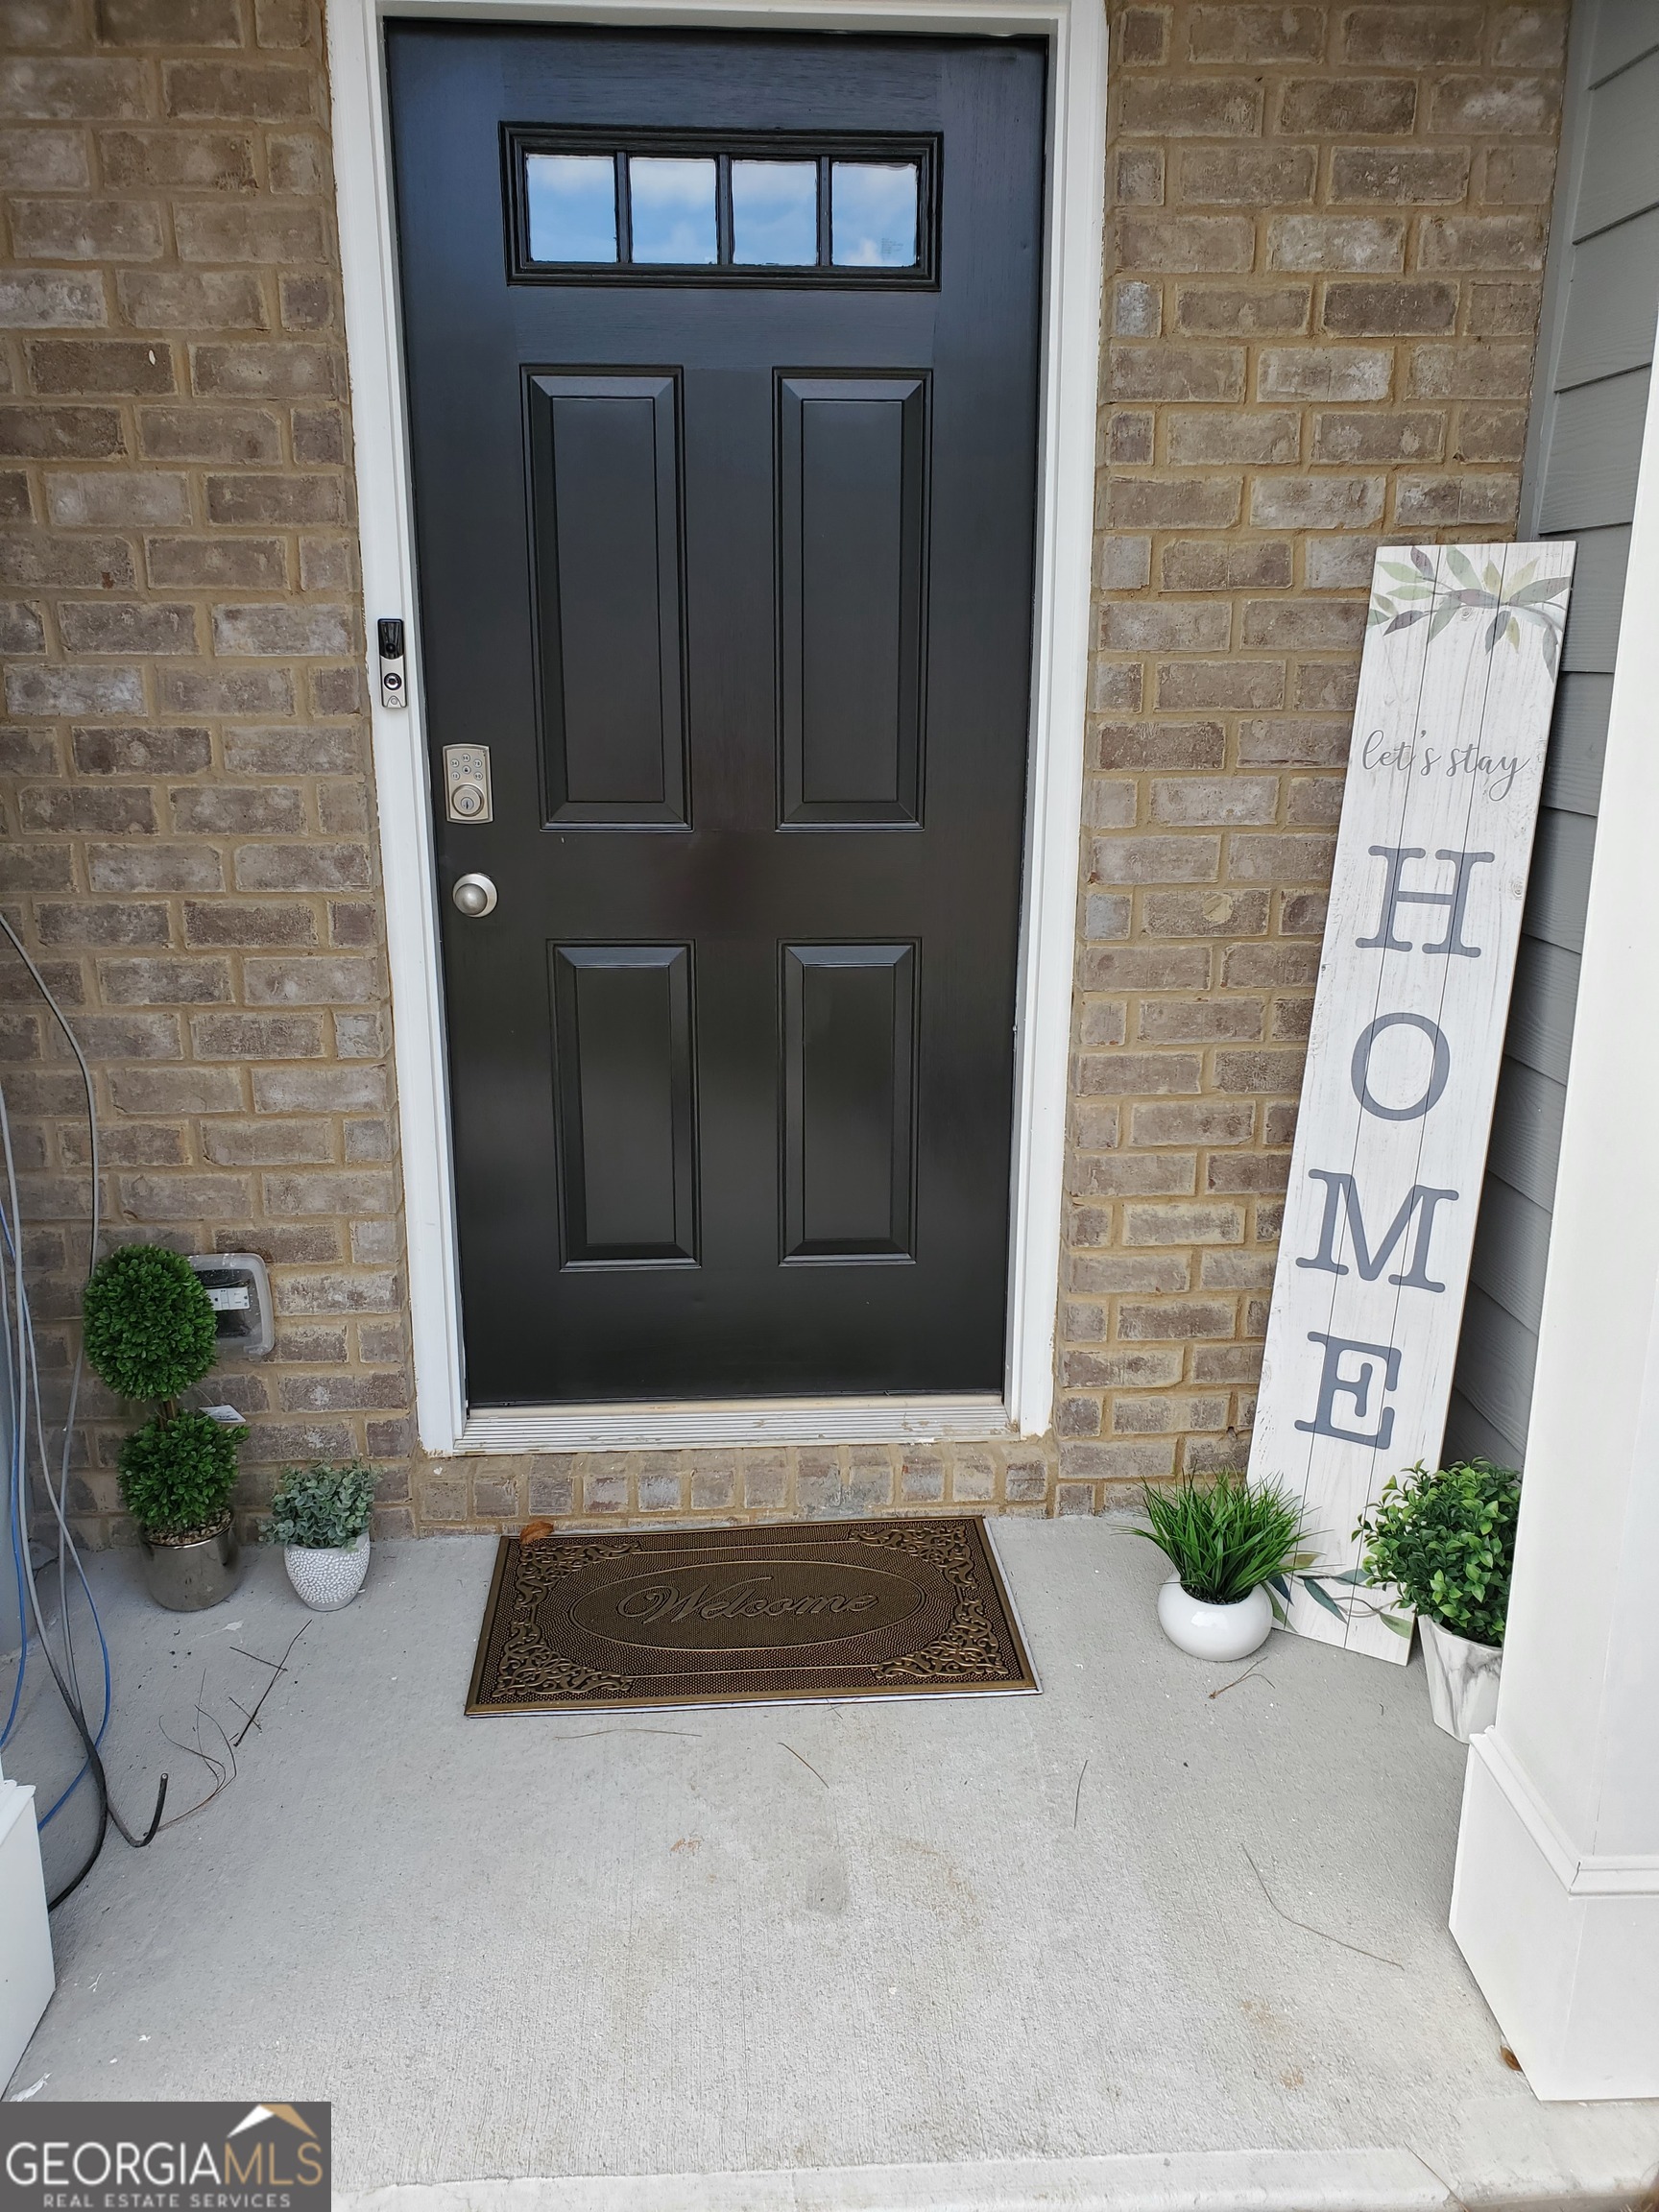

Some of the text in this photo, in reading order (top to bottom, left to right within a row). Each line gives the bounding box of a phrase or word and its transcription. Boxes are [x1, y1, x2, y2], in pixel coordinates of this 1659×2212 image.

[1362, 730, 1530, 802] let's stay
[1294, 845, 1496, 1450] HOME
[616, 1576, 880, 1624] Welcome
